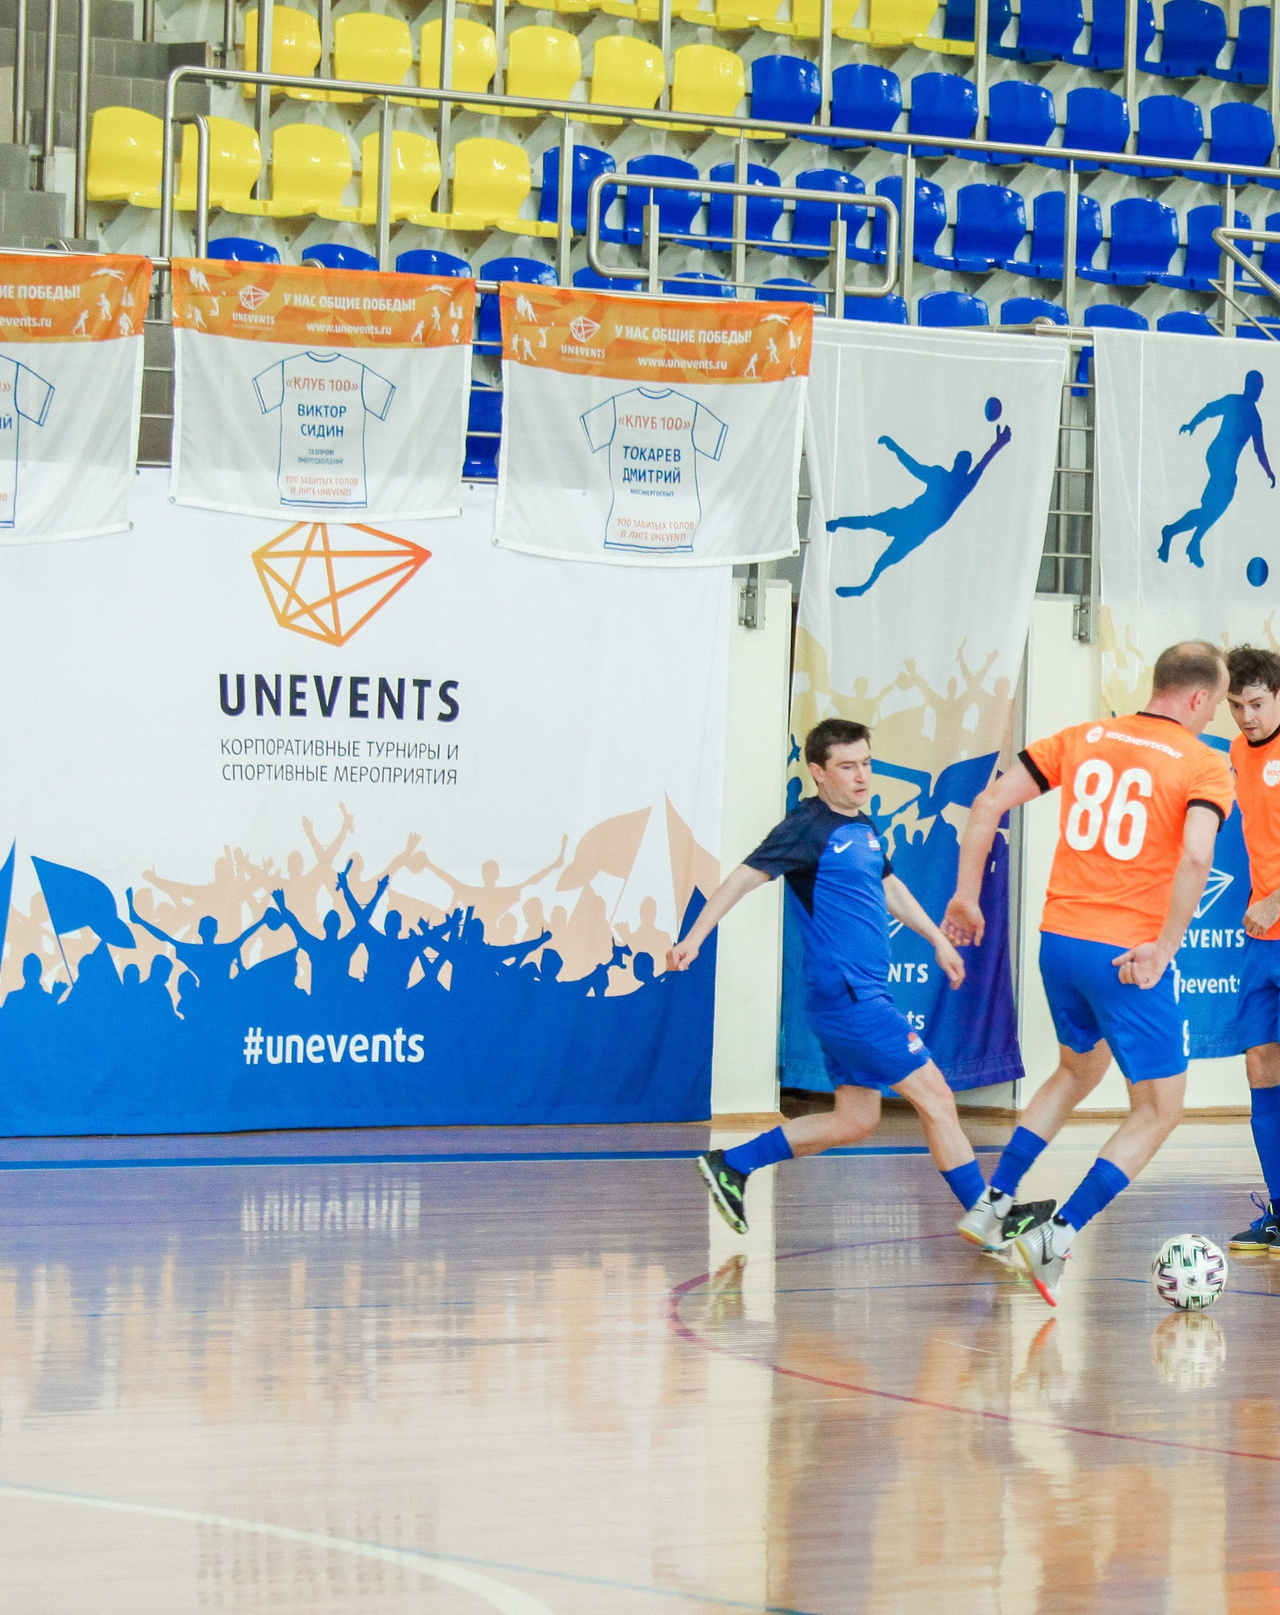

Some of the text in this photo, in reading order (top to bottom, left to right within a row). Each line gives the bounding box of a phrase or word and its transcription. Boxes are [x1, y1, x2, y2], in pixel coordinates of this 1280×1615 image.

[18, 285, 80, 301] ПОБЕДЫ!
[284, 293, 416, 313] У НАС ОБЩИЕ ПОБЕДЫ!
[232, 312, 275, 325] UNEVENTS
[307, 323, 392, 335] www.unevents.ru
[615, 324, 752, 346] У НАС ОБЩИЕ ПОБЕДЫ!
[561, 344, 606, 359] UNEVENTS
[638, 357, 727, 370] www.unevents.ru
[286, 377, 358, 392] «КЛУБ 100»
[297, 404, 347, 418] ВИКТОР
[618, 415, 691, 430] «КЛУБ 100»
[301, 424, 344, 438] СИДИН
[623, 446, 681, 462] ТОКАРЕВ
[622, 467, 681, 484] ДМИТРИЙ
[633, 520, 667, 530] ЗАБИТЫХ
[669, 521, 694, 530] ГОЛОВ
[218, 673, 460, 722] UNEVENTS
[220, 738, 459, 760] КОРПОРАТИВНЫЕ ТУРНИРЫ И
[1105, 731, 1183, 759] МОСЭНЕРГОСБЫТ
[222, 764, 458, 785] СПОРТИВНЫЕ МЕРОПРИЯТИЯ
[1065, 758, 1153, 861] 86
[243, 1026, 425, 1065] #unevents
